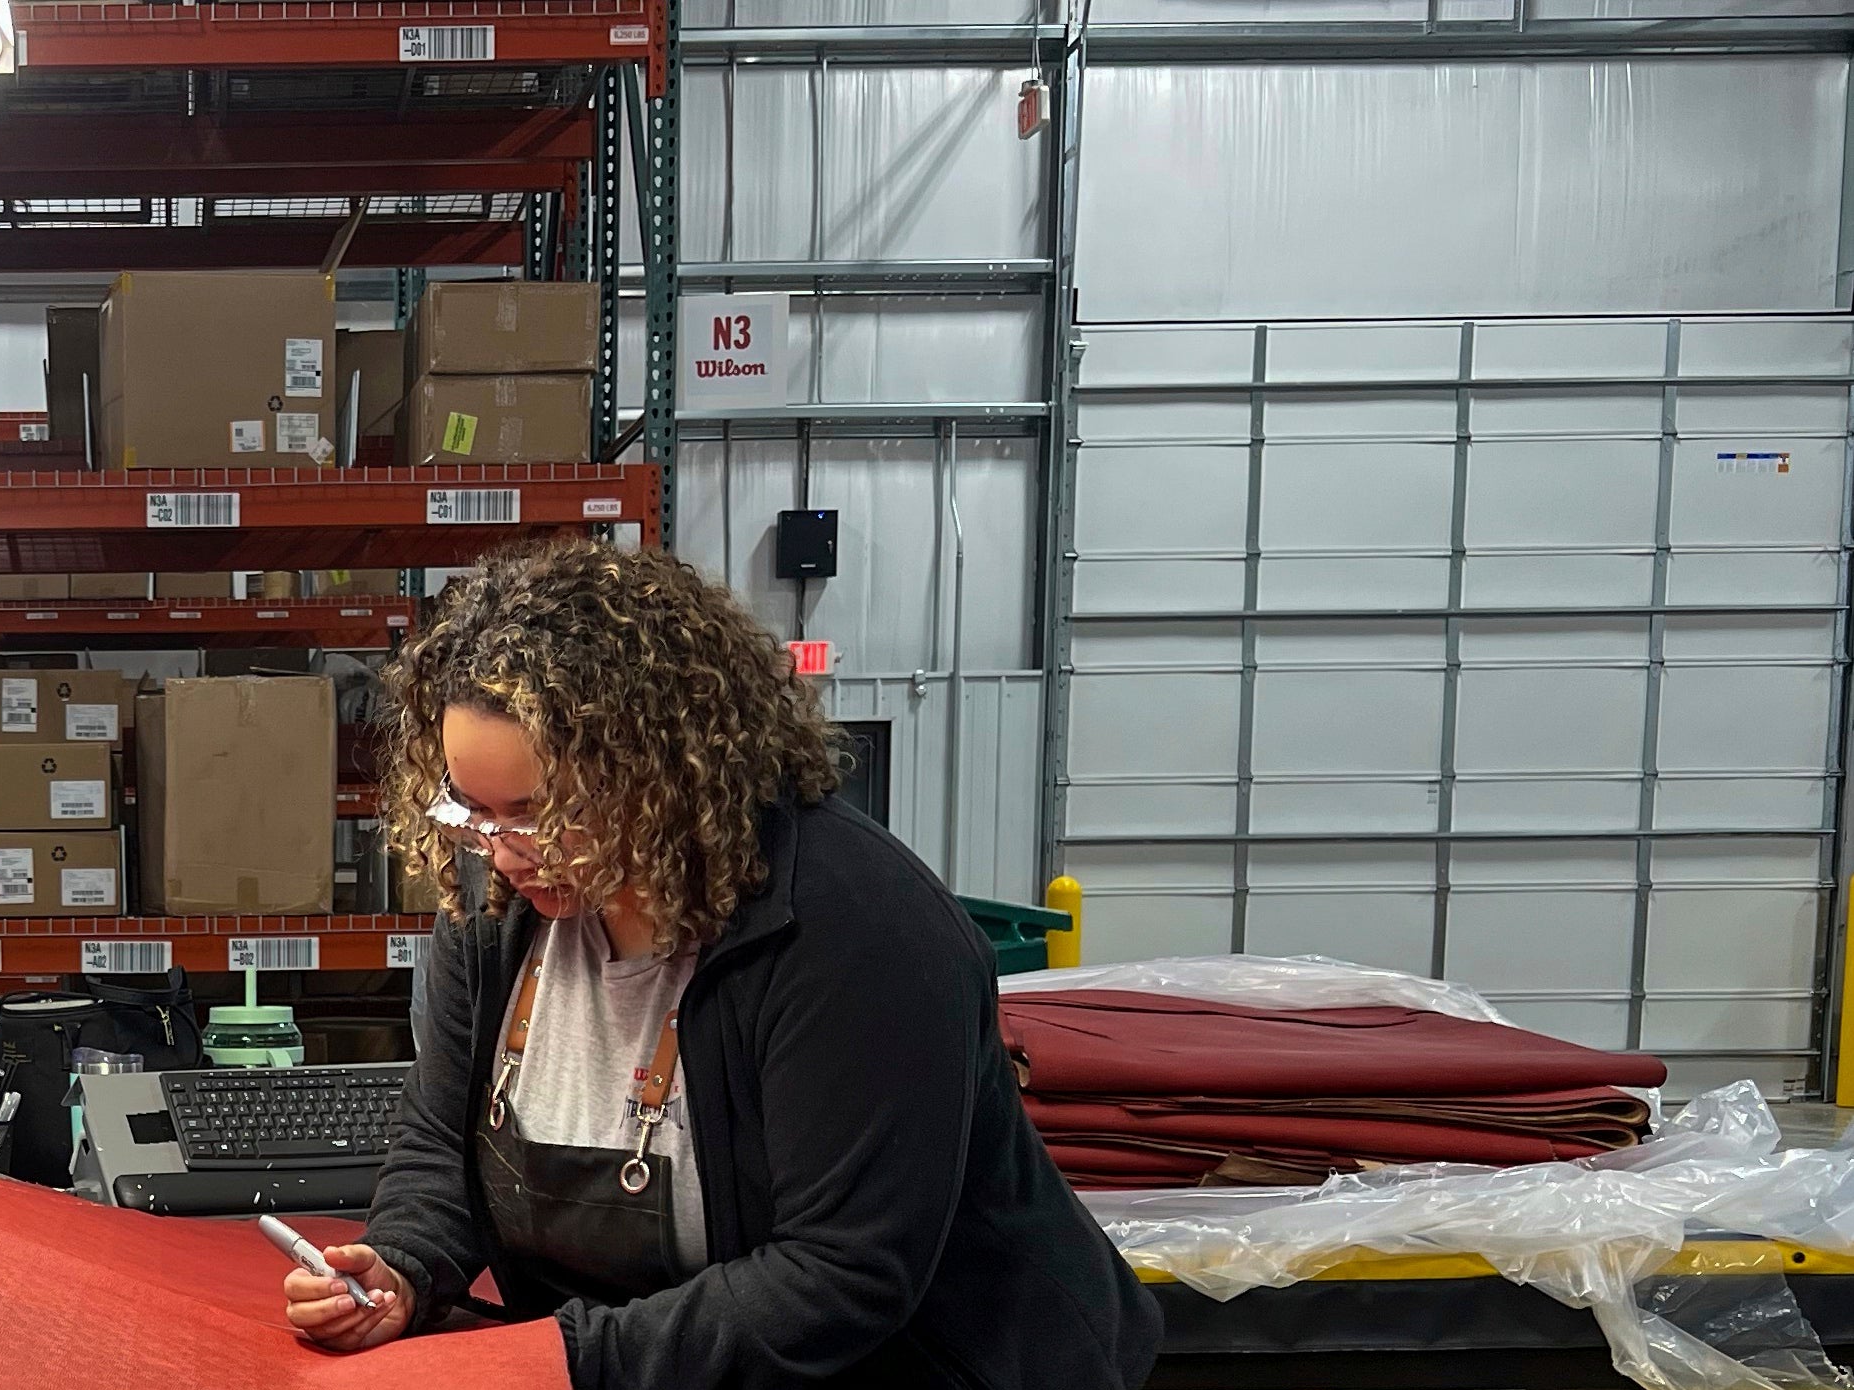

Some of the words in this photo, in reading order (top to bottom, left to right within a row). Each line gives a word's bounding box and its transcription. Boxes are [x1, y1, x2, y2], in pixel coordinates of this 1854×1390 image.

[403, 28, 420, 40] N3A
[404, 43, 426, 56] -D01
[713, 315, 751, 350] N3
[695, 358, 767, 378] Wilson
[150, 495, 167, 506] N3A
[430, 492, 447, 503] N3A
[431, 505, 453, 518] -C01
[232, 941, 248, 951] N3A
[390, 937, 407, 947] N3A
[84, 943, 101, 954] N3A
